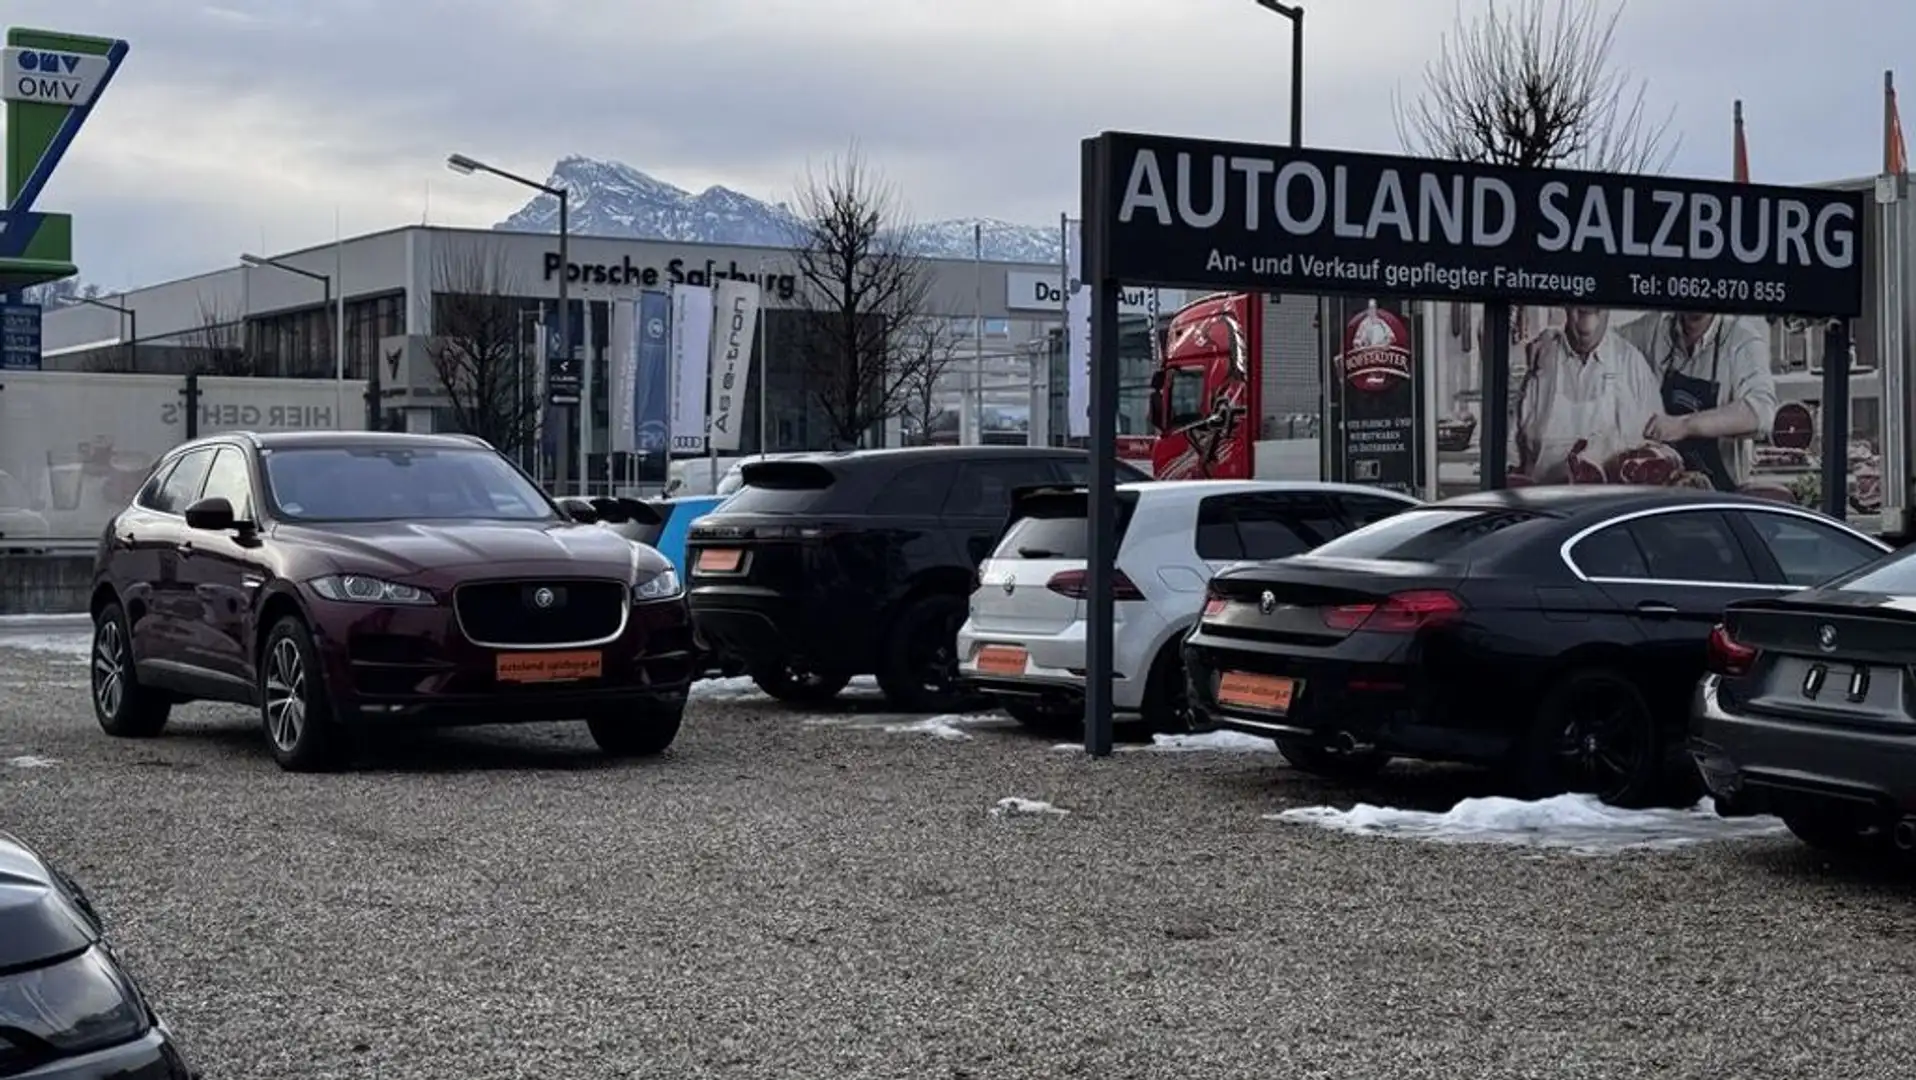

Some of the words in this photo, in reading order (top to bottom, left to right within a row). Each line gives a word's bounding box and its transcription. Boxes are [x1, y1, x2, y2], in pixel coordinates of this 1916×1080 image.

[18, 77, 80, 99] OMV
[1119, 148, 1516, 247] AUTOLAND
[1537, 181, 1854, 269] SALZBURG
[543, 252, 659, 286] Porsche
[1206, 249, 1245, 273] An-
[1252, 253, 1292, 275] und
[1300, 255, 1380, 280] Verkauf
[1386, 260, 1487, 288] gepflegter
[1494, 267, 1596, 297] Fahrzeuge
[1035, 281, 1069, 302] Da
[1630, 273, 1662, 297] Tel:
[1667, 276, 1749, 301] 0662-870
[1754, 280, 1786, 302] 855
[722, 296, 747, 390] e-tron
